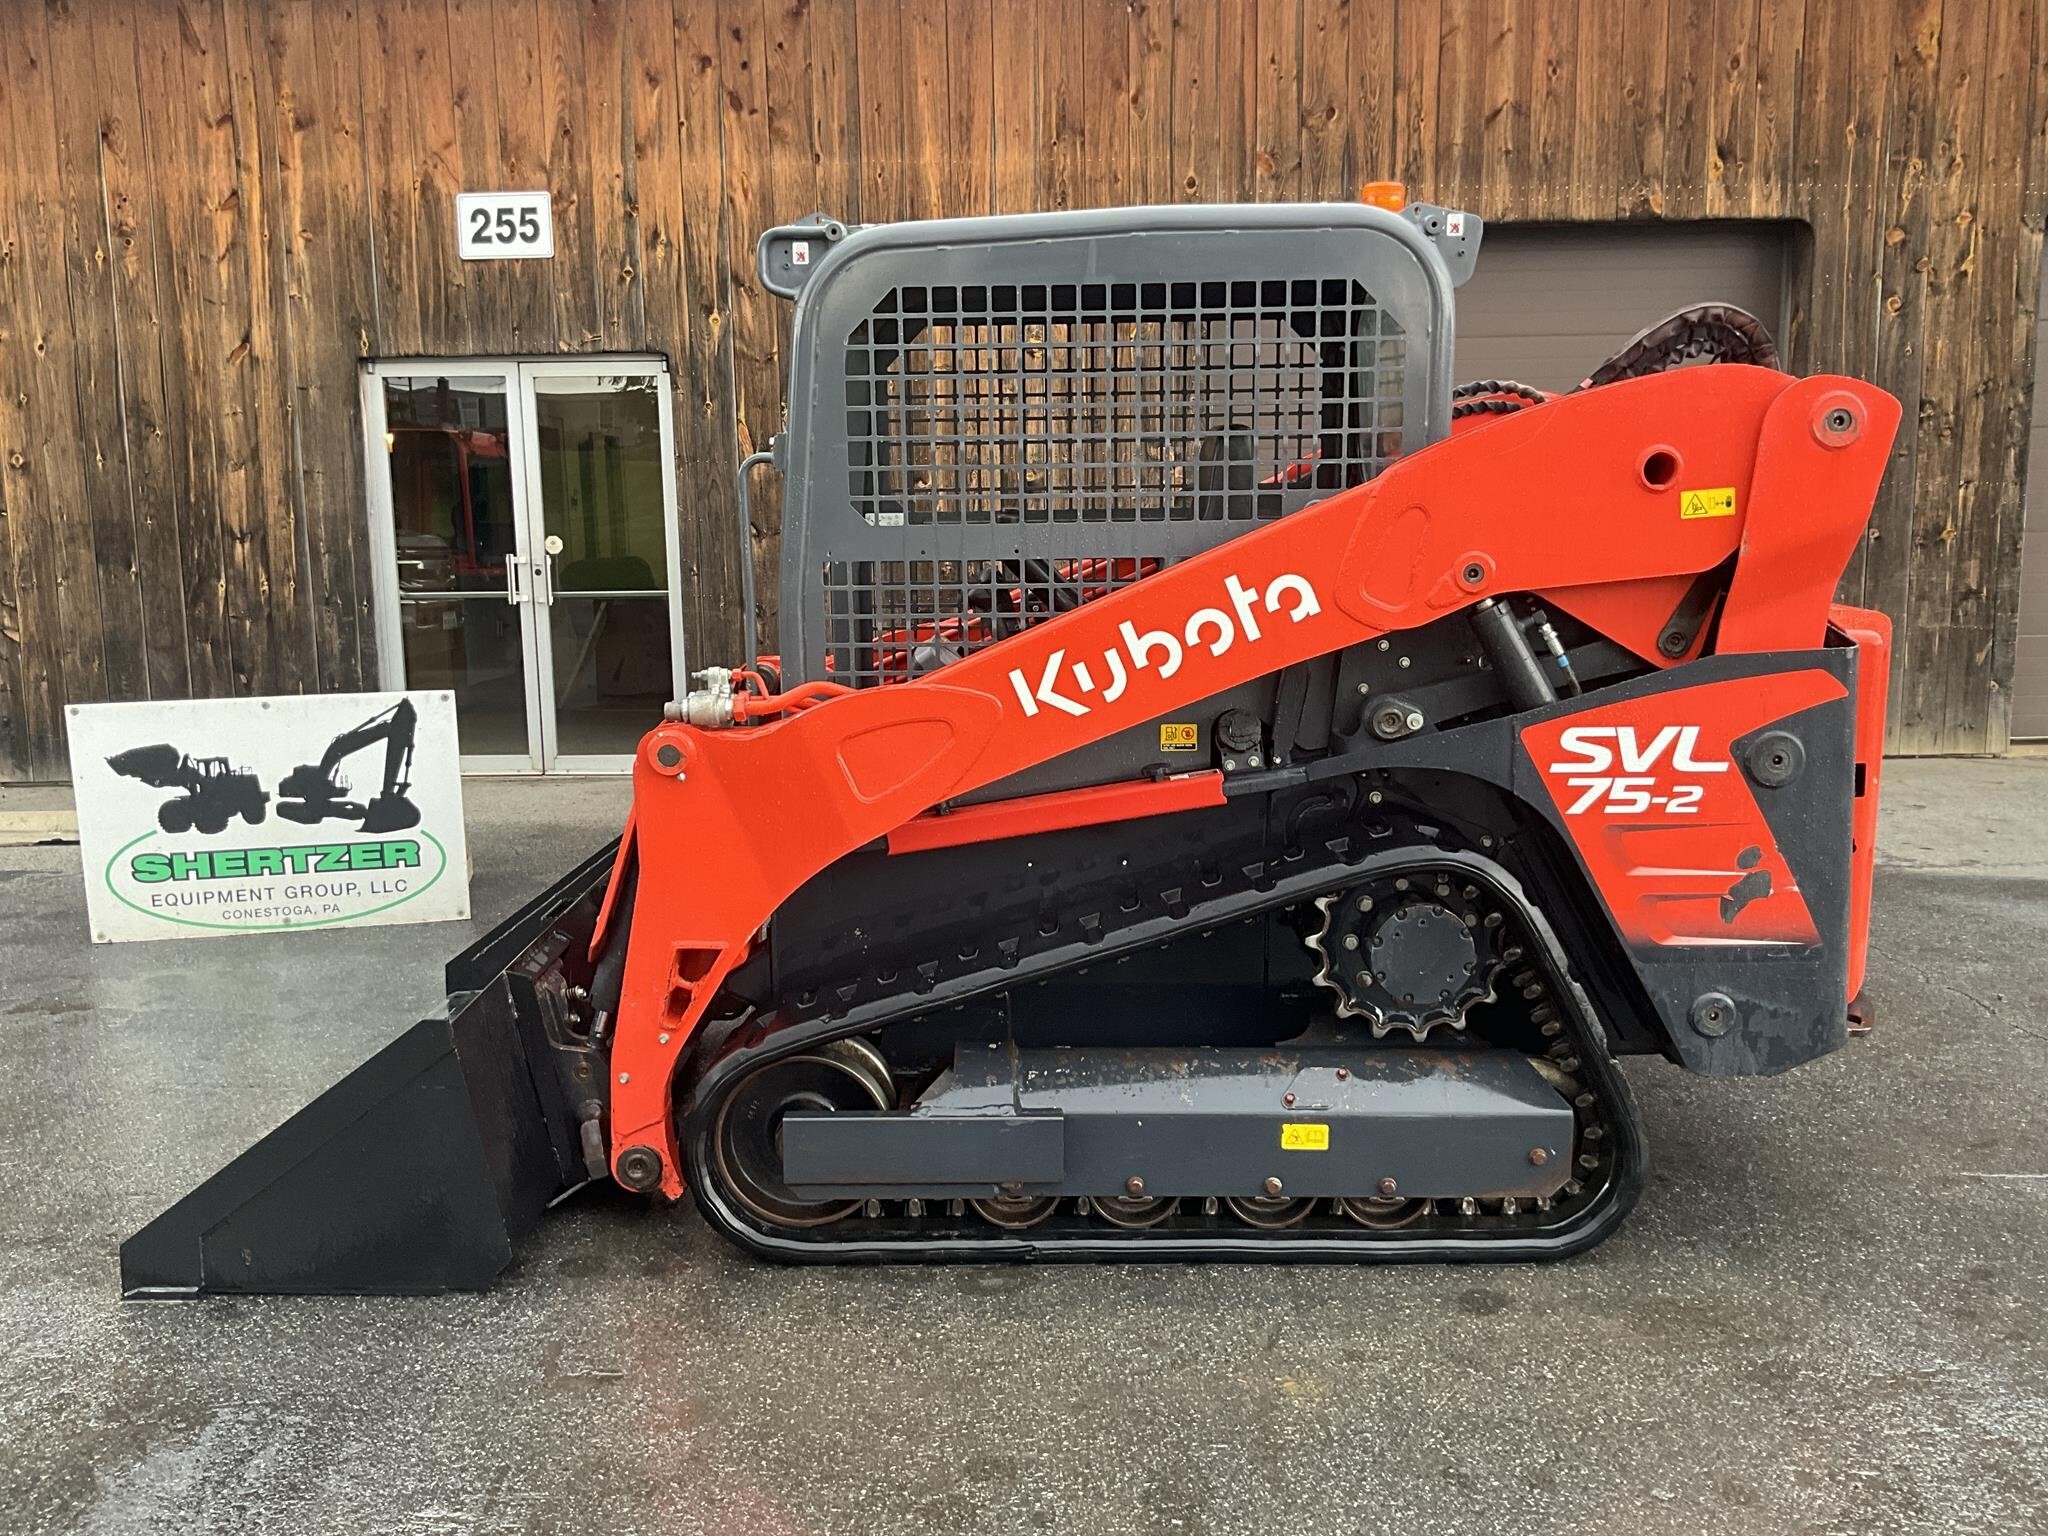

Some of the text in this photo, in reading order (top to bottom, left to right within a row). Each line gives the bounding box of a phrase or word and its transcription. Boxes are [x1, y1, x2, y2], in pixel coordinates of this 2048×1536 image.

[470, 207, 540, 244] 255
[1008, 574, 1322, 717] Kubota
[1549, 726, 1730, 773] SVL
[1565, 777, 1704, 814] 75-2
[131, 839, 421, 883] SHERTZER
[152, 879, 408, 907] EQUIPMENT GROUP, LLC
[222, 904, 341, 920] CONESTOGA, PA
